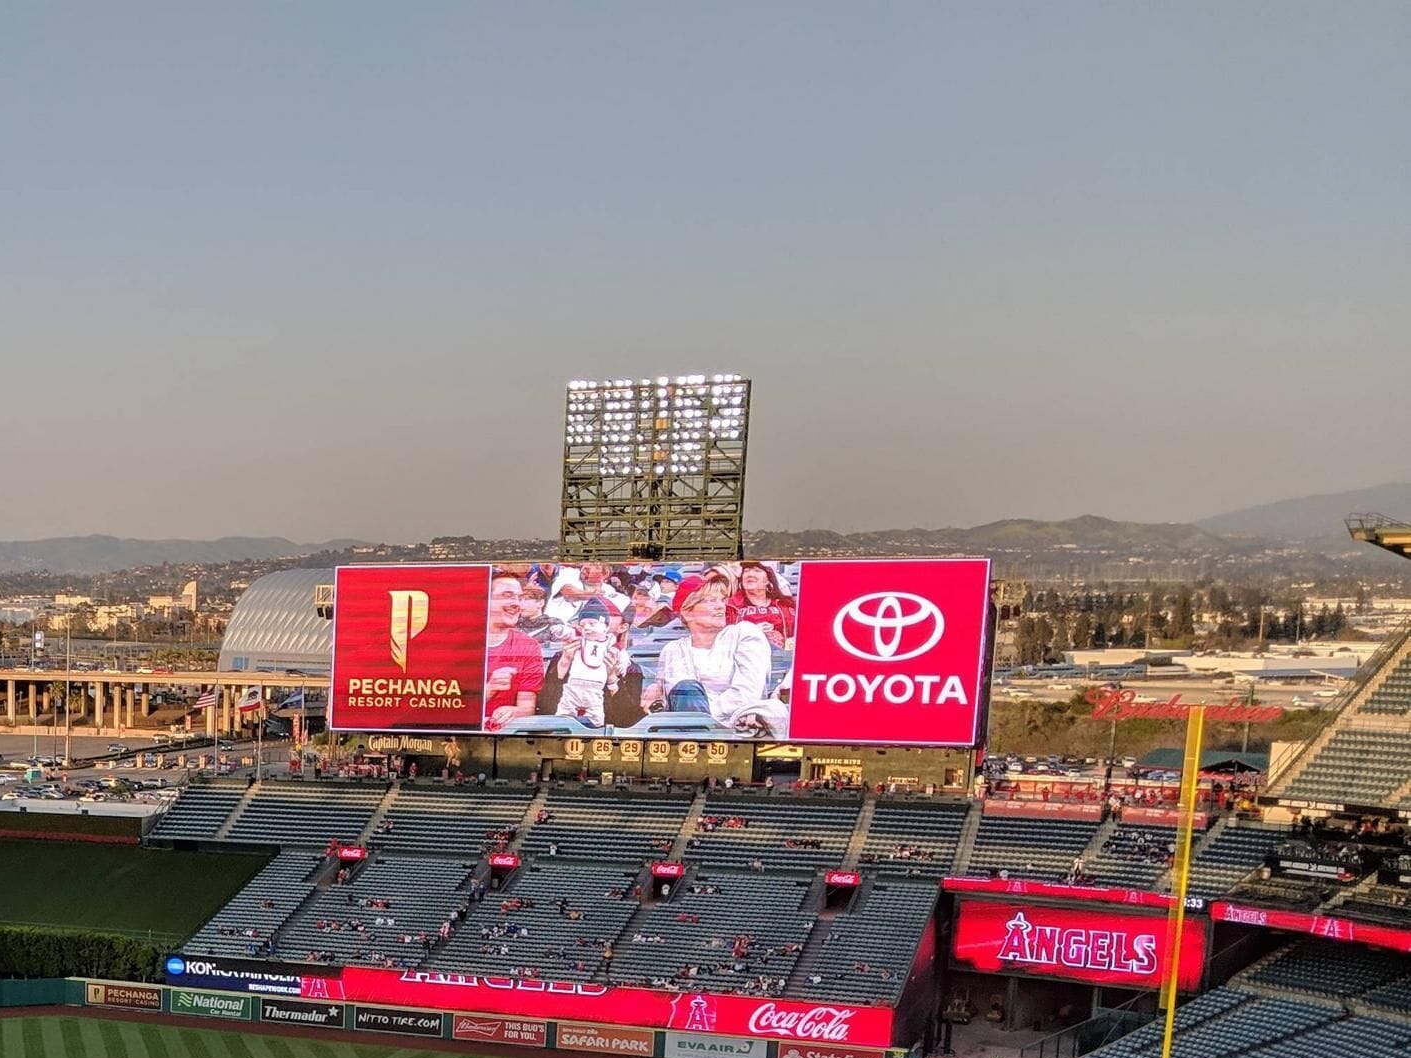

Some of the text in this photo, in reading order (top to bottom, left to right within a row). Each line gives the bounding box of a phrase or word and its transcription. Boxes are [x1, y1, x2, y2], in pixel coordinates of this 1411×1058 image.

[348, 678, 462, 696] PECHANGA
[801, 673, 968, 704] TOYOTA
[348, 697, 462, 709] RESORT CASINO
[368, 735, 433, 752] Captain Morgan
[570, 741, 579, 751] 11
[596, 742, 609, 752] 26
[624, 743, 638, 752] 29
[653, 743, 666, 753] 30
[682, 744, 695, 754] 42
[711, 744, 724, 755] 50
[1223, 905, 1267, 926] ANGELS
[998, 912, 1158, 975] ANGELS
[107, 988, 159, 1001] PECHANGA
[192, 994, 244, 1011] National
[222, 1008, 241, 1017] Rental
[265, 1005, 328, 1023] Thermador
[358, 1012, 440, 1031] NITTO TIRE.COM
[505, 1022, 545, 1033] THIS BUD'S
[748, 1002, 856, 1041] Coca-Cola
[504, 1031, 537, 1041] FOR YOU.
[561, 1033, 649, 1052] SAFARI PARK
[677, 1040, 734, 1053] EVA AIR
